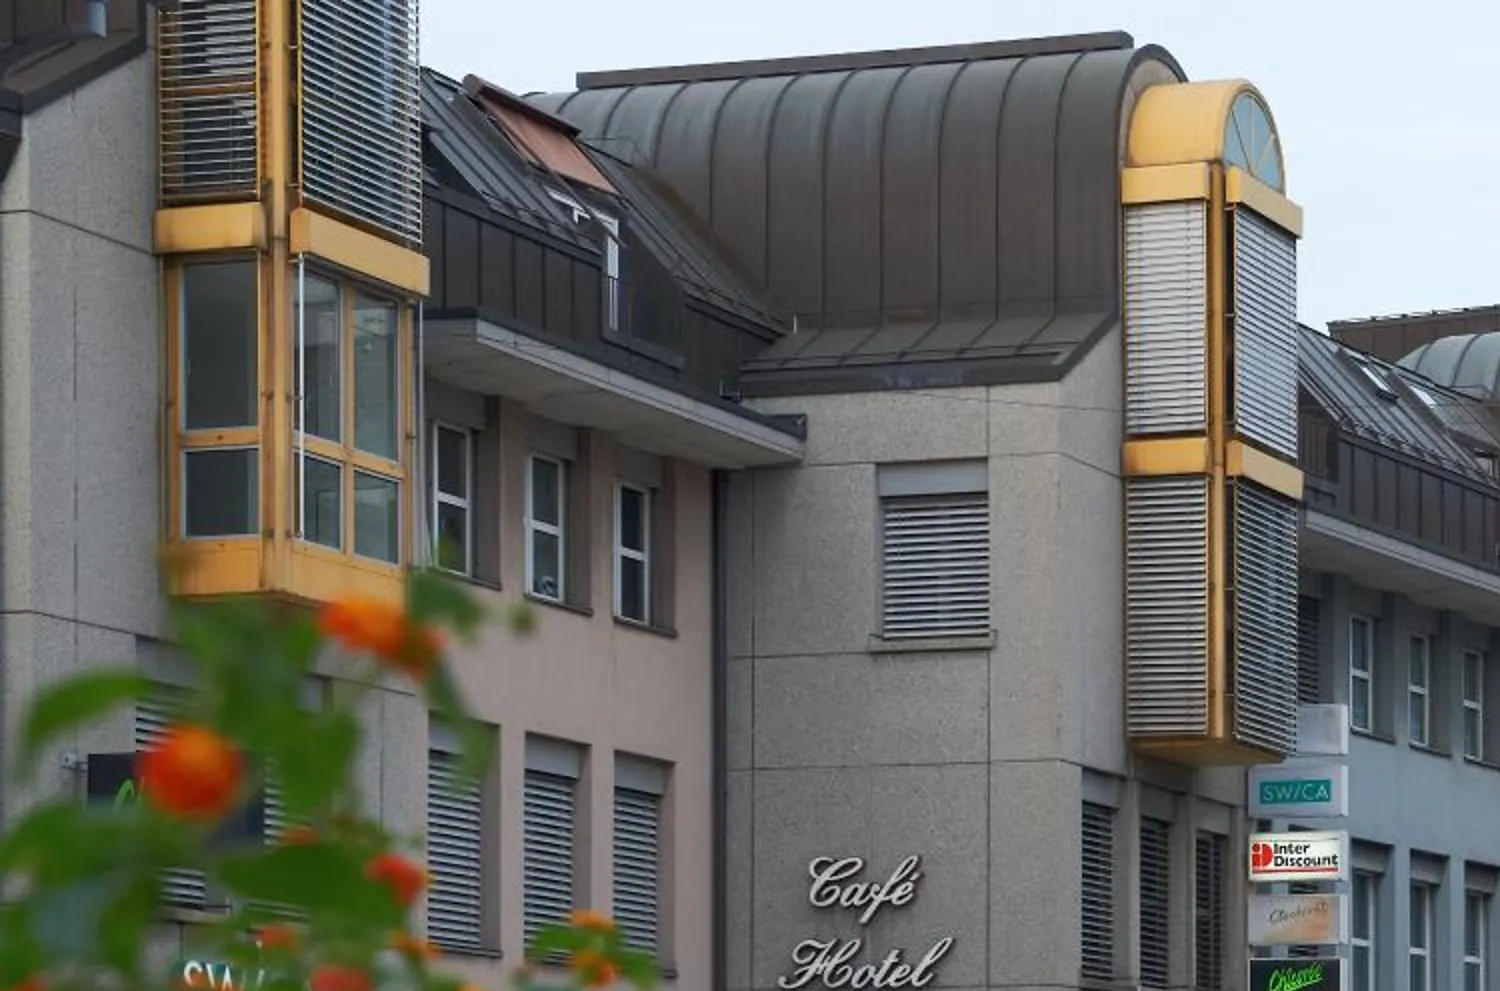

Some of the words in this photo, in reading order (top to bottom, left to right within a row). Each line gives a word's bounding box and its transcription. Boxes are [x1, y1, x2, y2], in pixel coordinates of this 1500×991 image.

[1273, 843, 1310, 855] Inter
[1273, 853, 1339, 867] Discount
[809, 855, 922, 924] Café
[777, 937, 953, 990] Hotel
